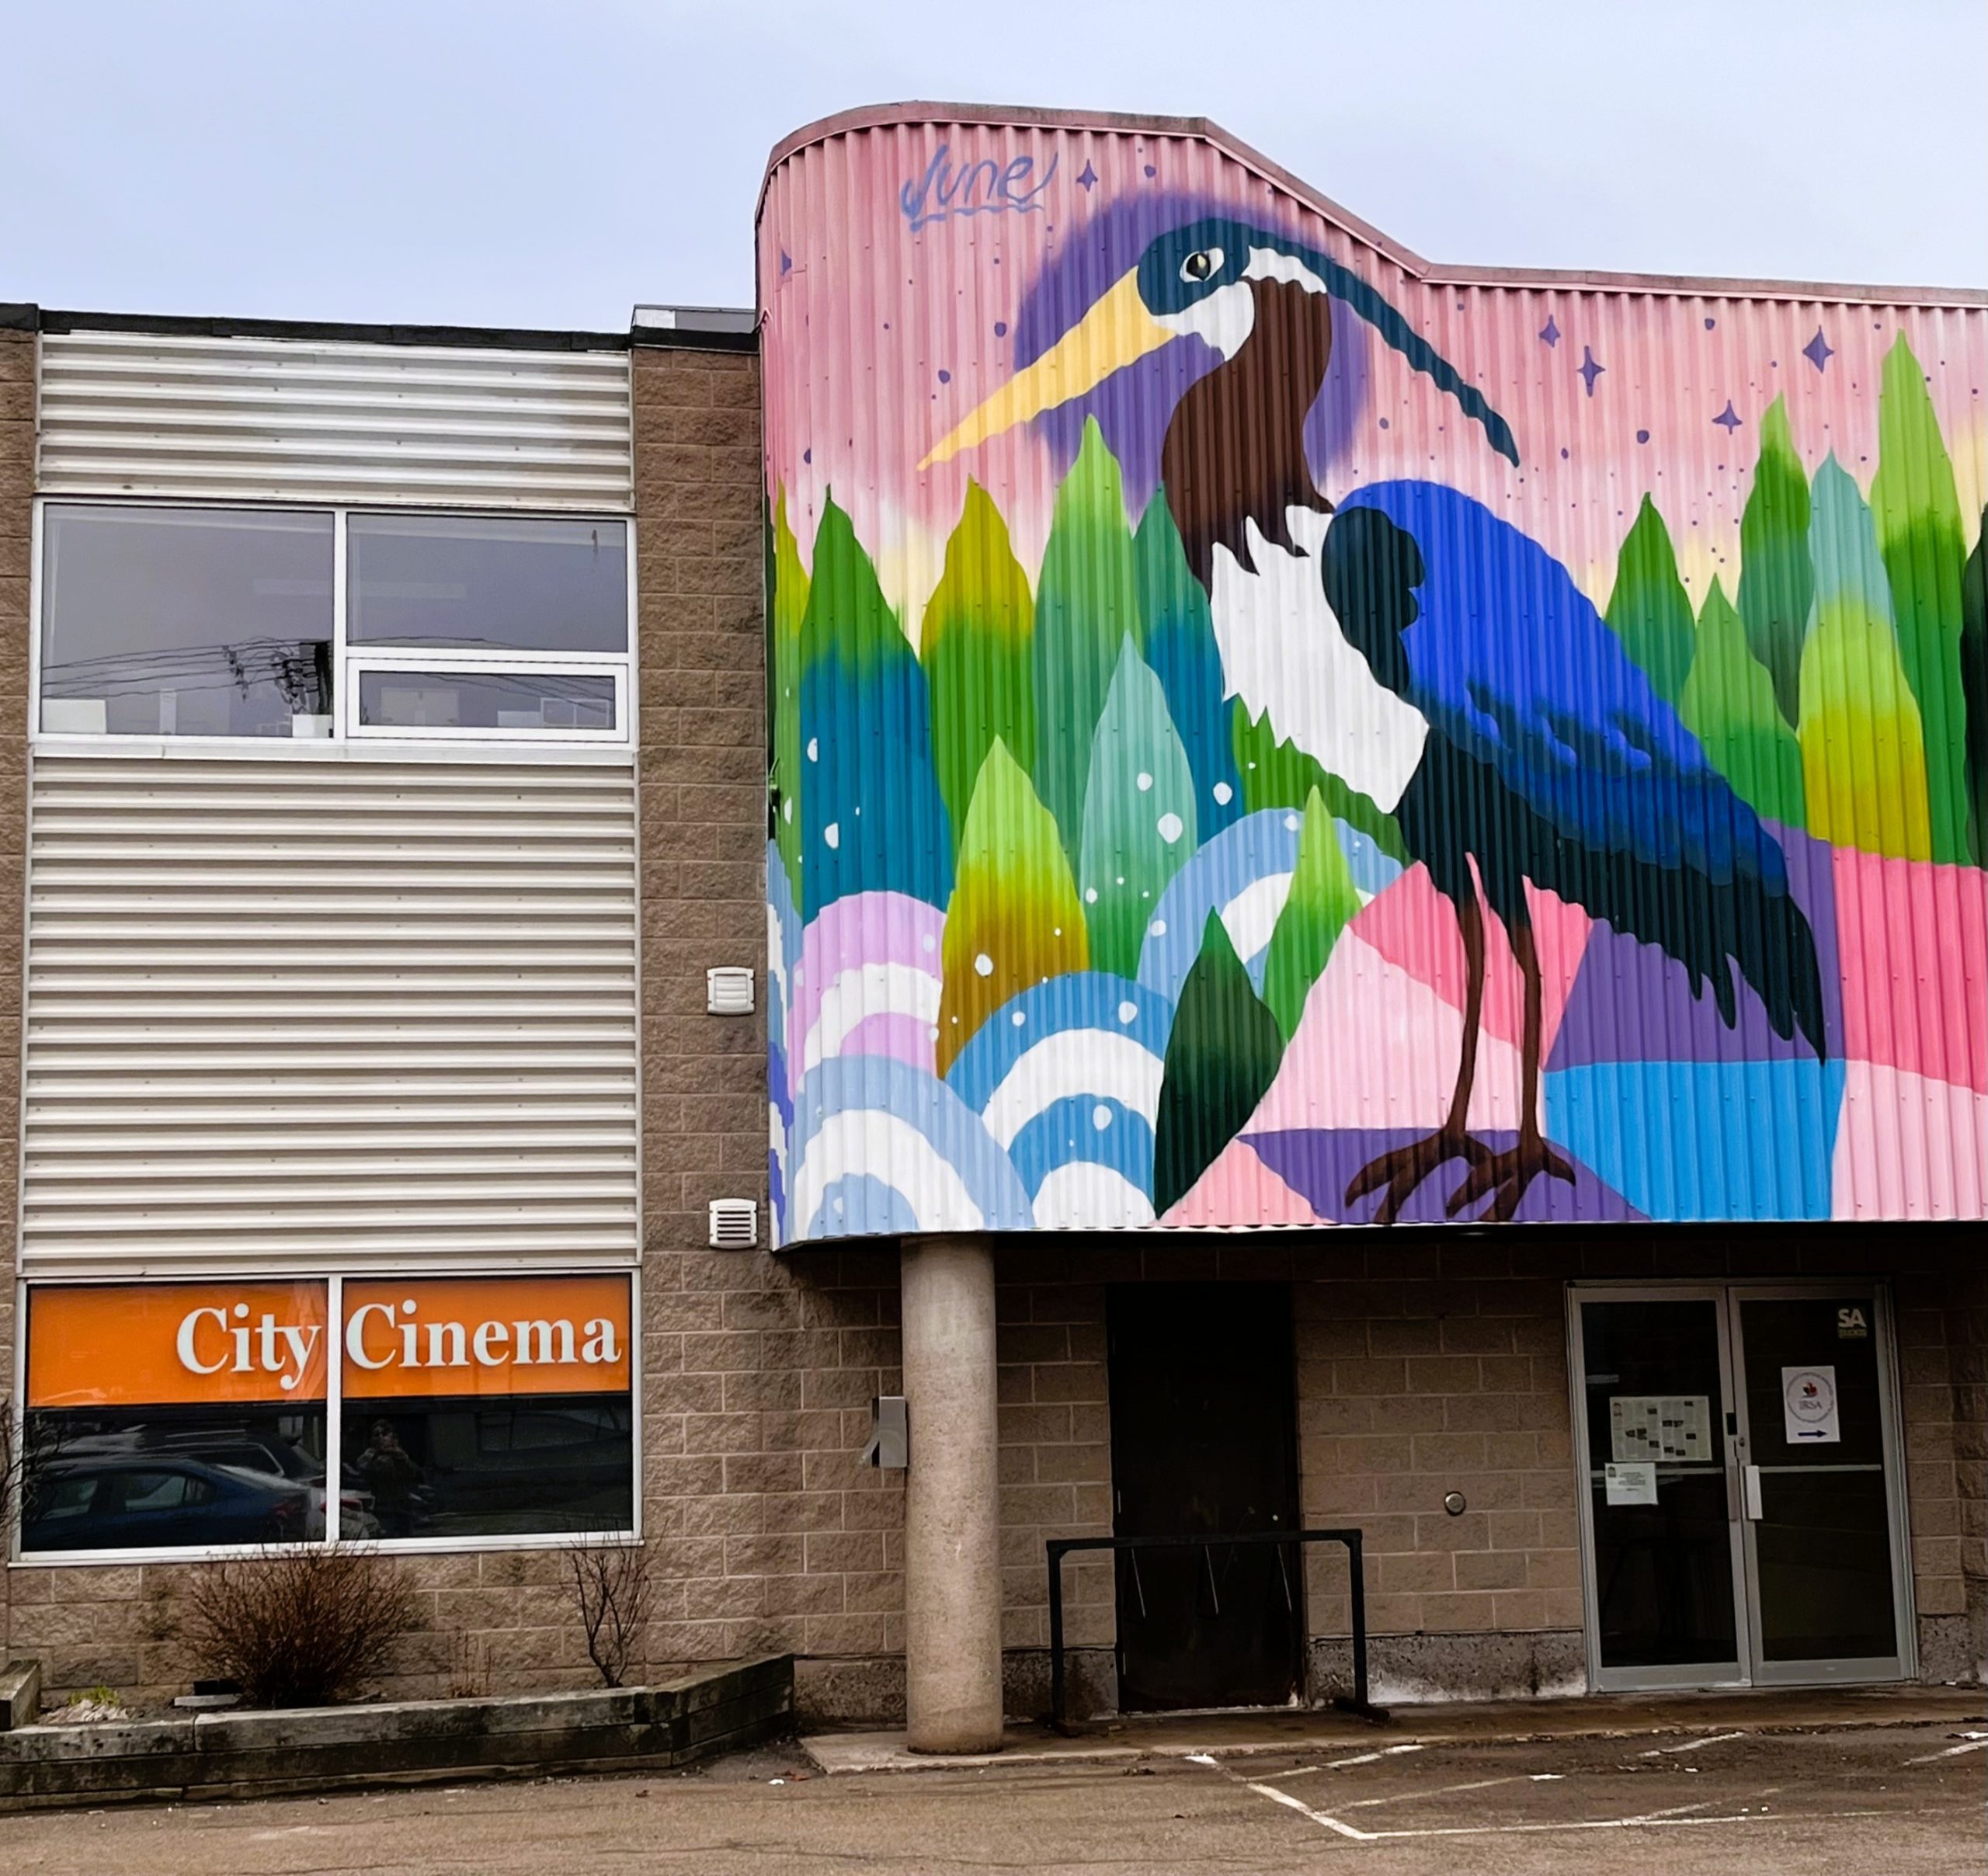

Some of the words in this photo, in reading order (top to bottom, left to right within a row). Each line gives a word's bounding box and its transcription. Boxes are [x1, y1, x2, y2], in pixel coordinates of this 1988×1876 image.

[901, 144, 1058, 220] June
[176, 1303, 322, 1390] City
[345, 1299, 621, 1369] Cinema
[1838, 1308, 1867, 1328] SA
